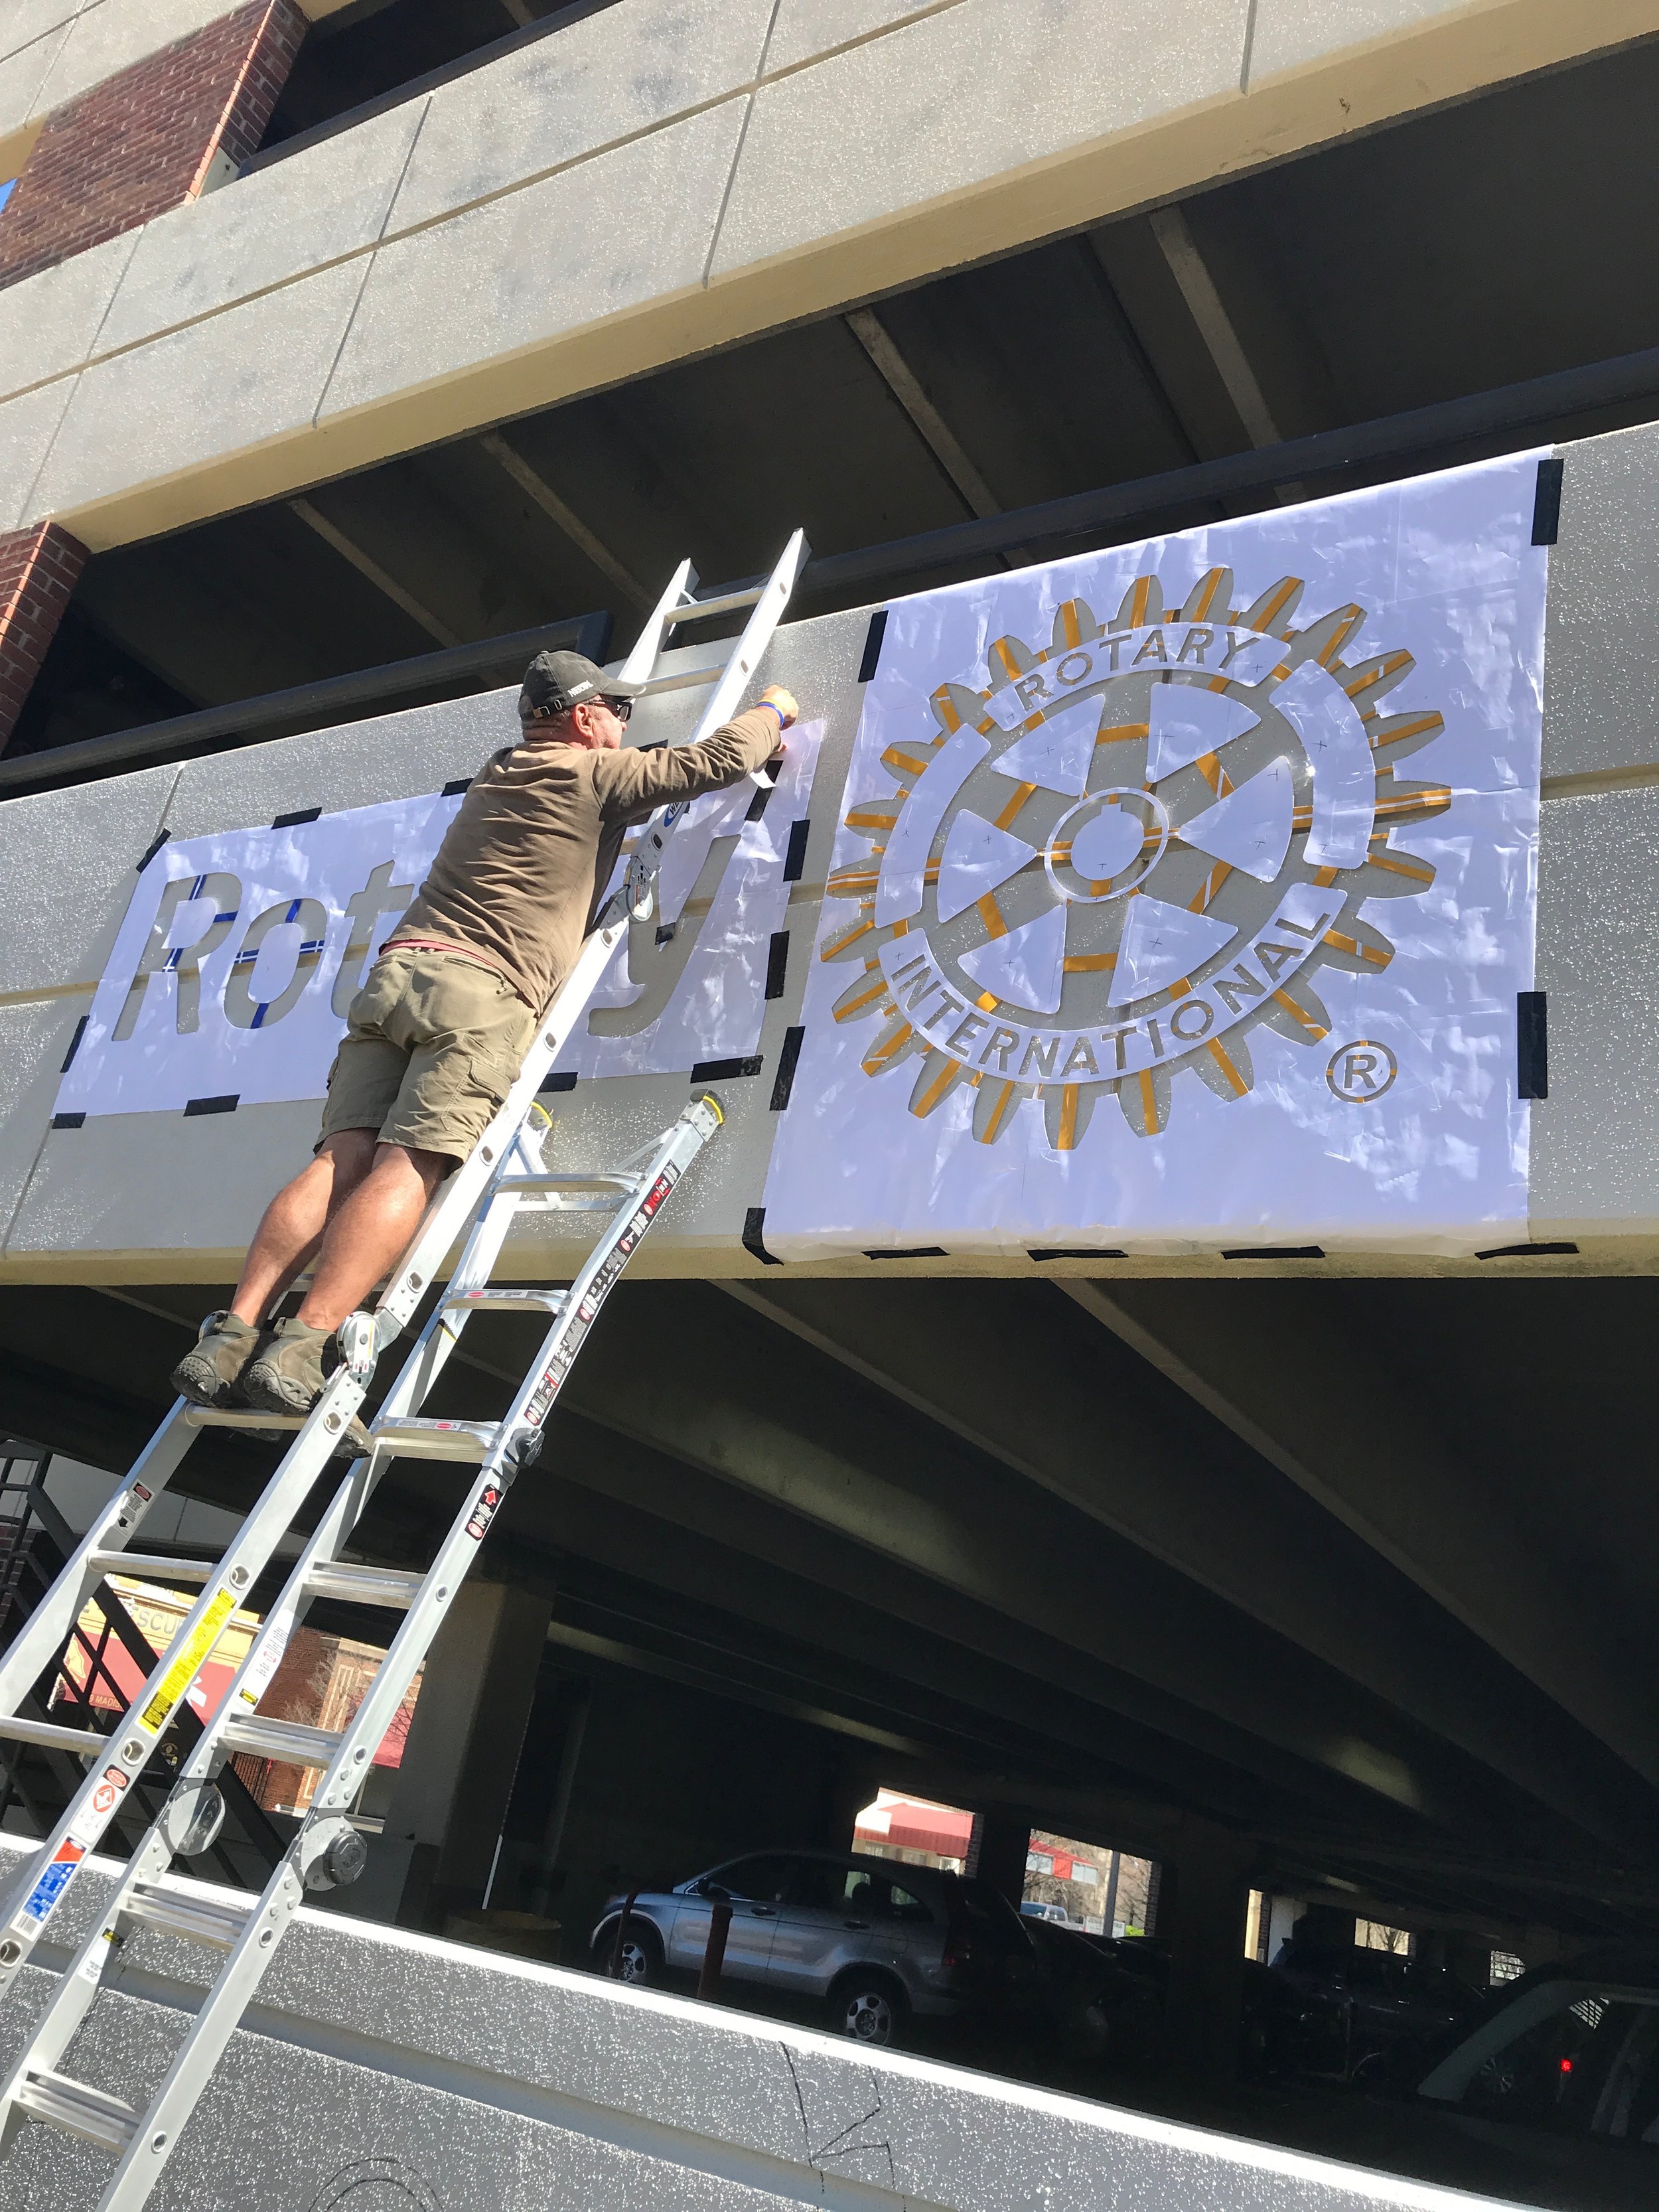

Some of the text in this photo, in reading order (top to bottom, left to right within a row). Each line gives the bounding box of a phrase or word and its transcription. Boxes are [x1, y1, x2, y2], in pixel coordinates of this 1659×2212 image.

[1014, 628, 1261, 713] ROTARY
[111, 834, 742, 1041] Roty
[890, 913, 1331, 1078] INTERNATIONAL
[132, 1605, 184, 1635] SCU
[96, 1695, 120, 1708] MADIS
